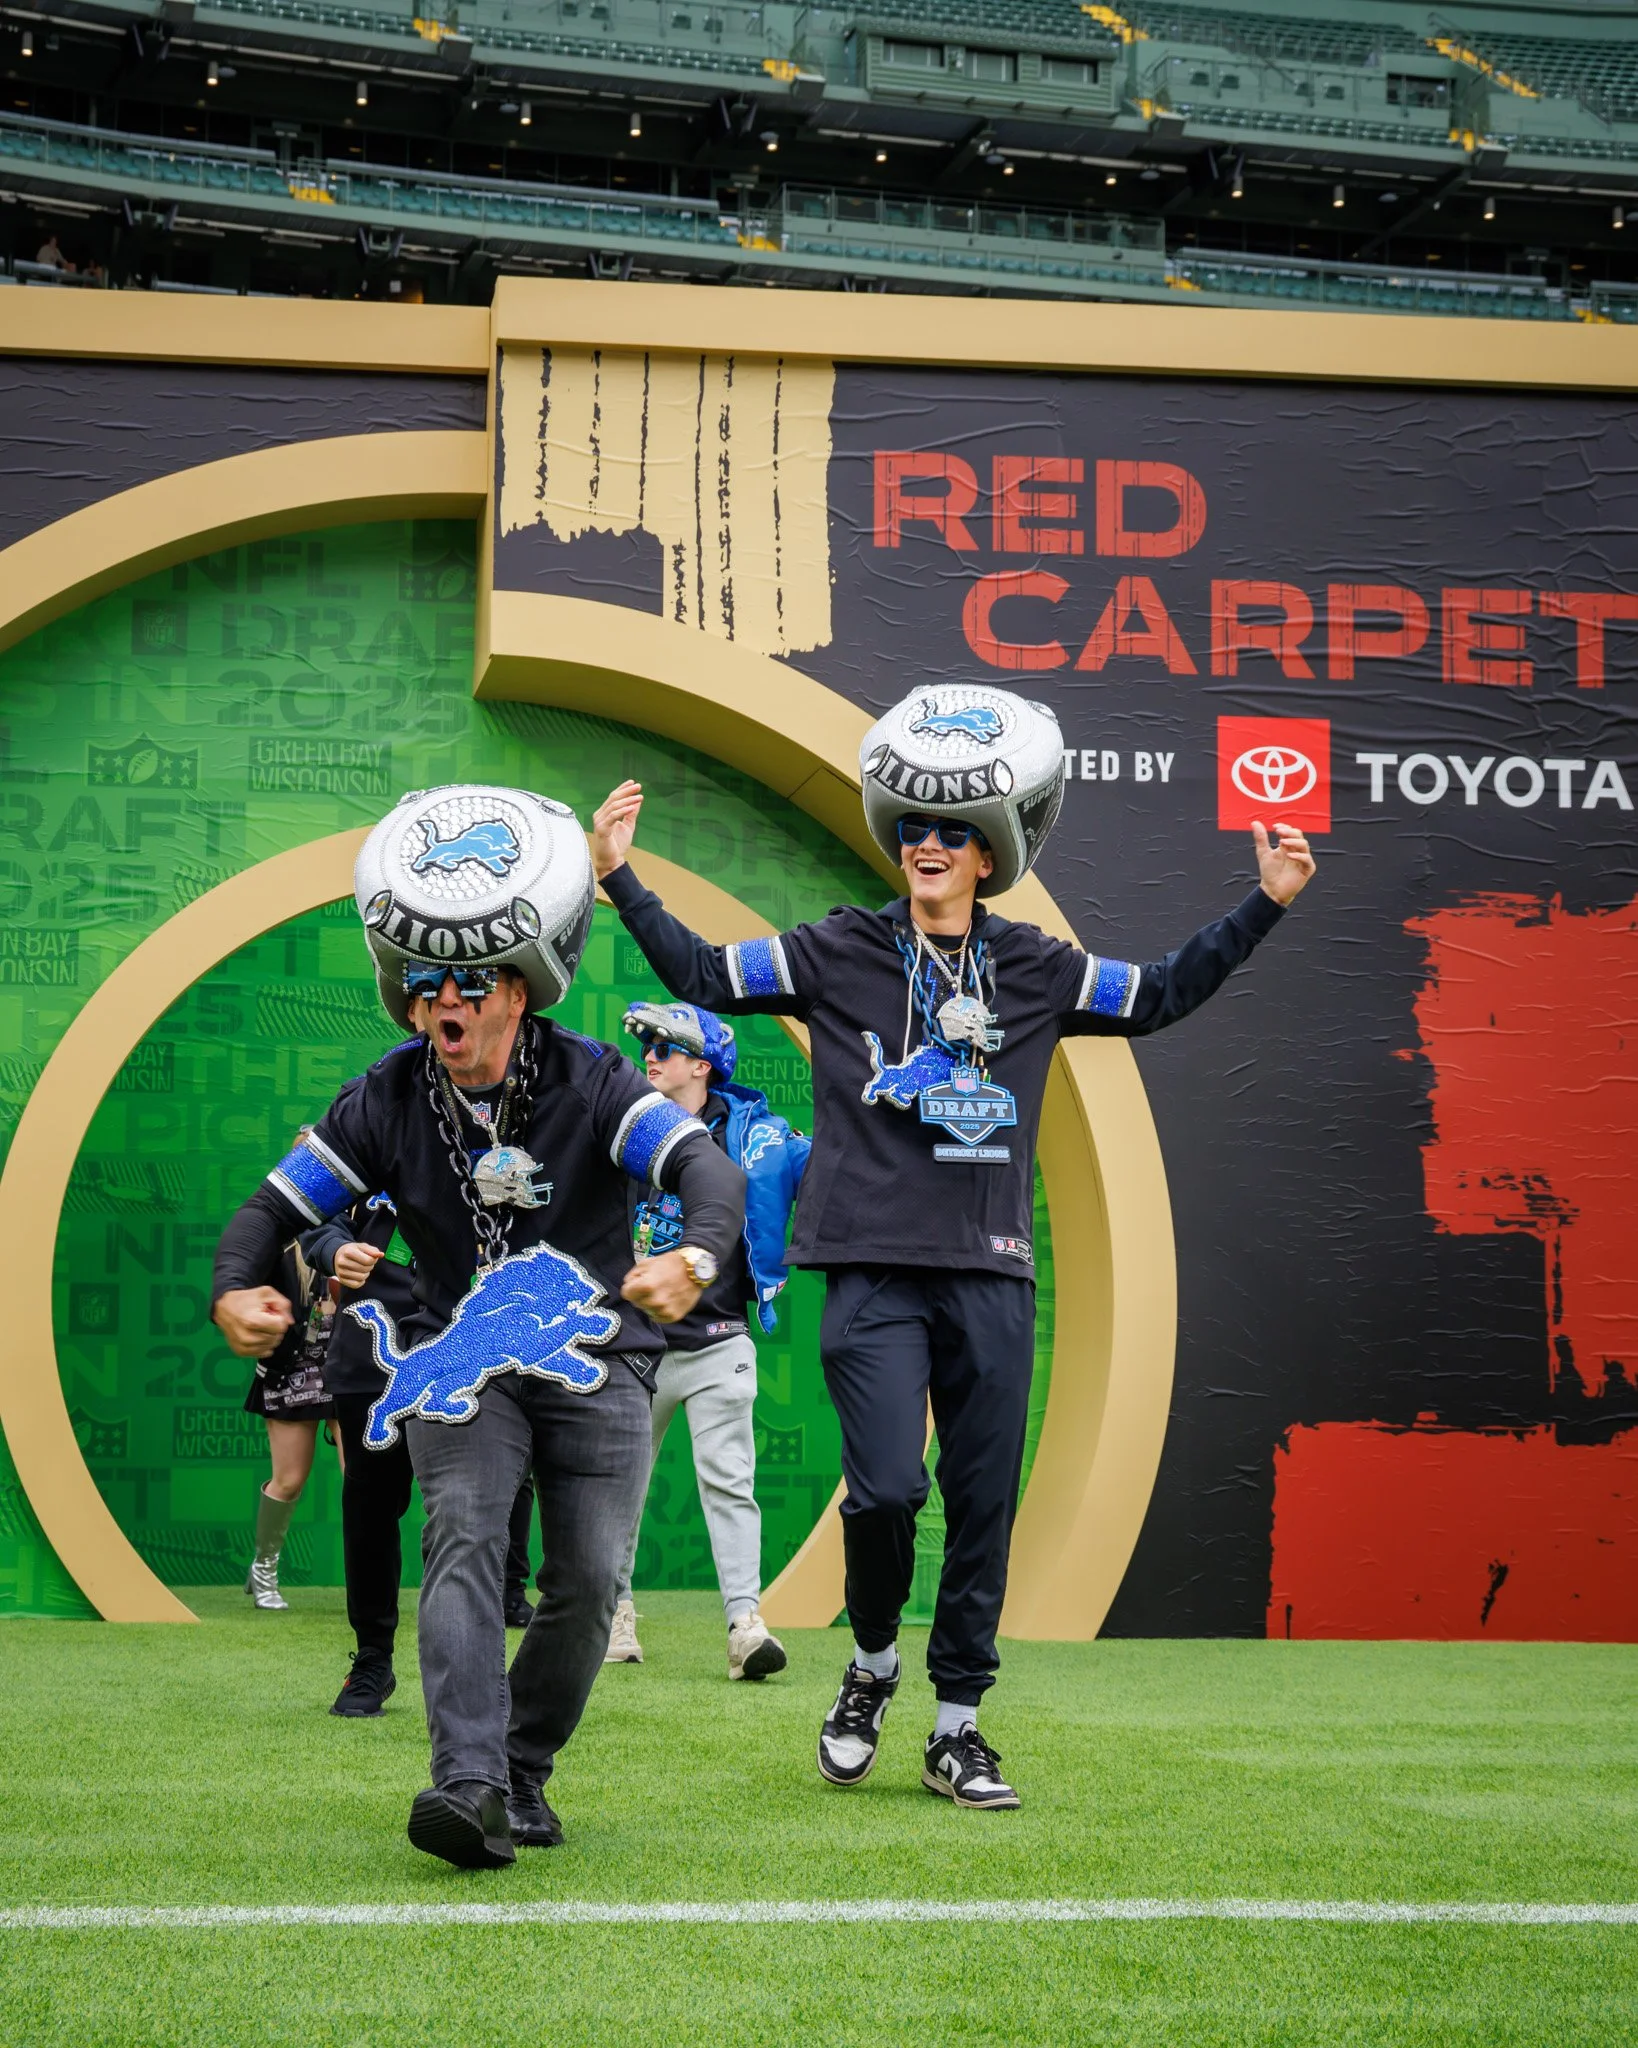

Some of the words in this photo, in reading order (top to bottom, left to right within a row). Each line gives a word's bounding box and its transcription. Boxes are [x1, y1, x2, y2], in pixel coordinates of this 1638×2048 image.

[871, 450, 1207, 558] RED
[221, 603, 475, 668] DRAF
[962, 569, 1638, 689] CARPET
[217, 670, 469, 733] 2025
[257, 740, 333, 765] GREEN
[340, 743, 383, 767] BAY
[1135, 751, 1175, 782] BY
[252, 767, 388, 794] WISCONSIN
[878, 756, 988, 801] LIONS
[1355, 752, 1634, 810] TOYOTA
[0, 793, 247, 857] RAFT
[383, 909, 516, 958] LIONS
[627, 959, 650, 973] NFL
[173, 1043, 347, 1096] THE
[731, 1058, 788, 1080] REEN
[954, 1078, 976, 1091] NFL
[927, 1100, 1009, 1118] DRAFT
[105, 1222, 222, 1275] NF
[181, 1409, 249, 1433] GREEN
